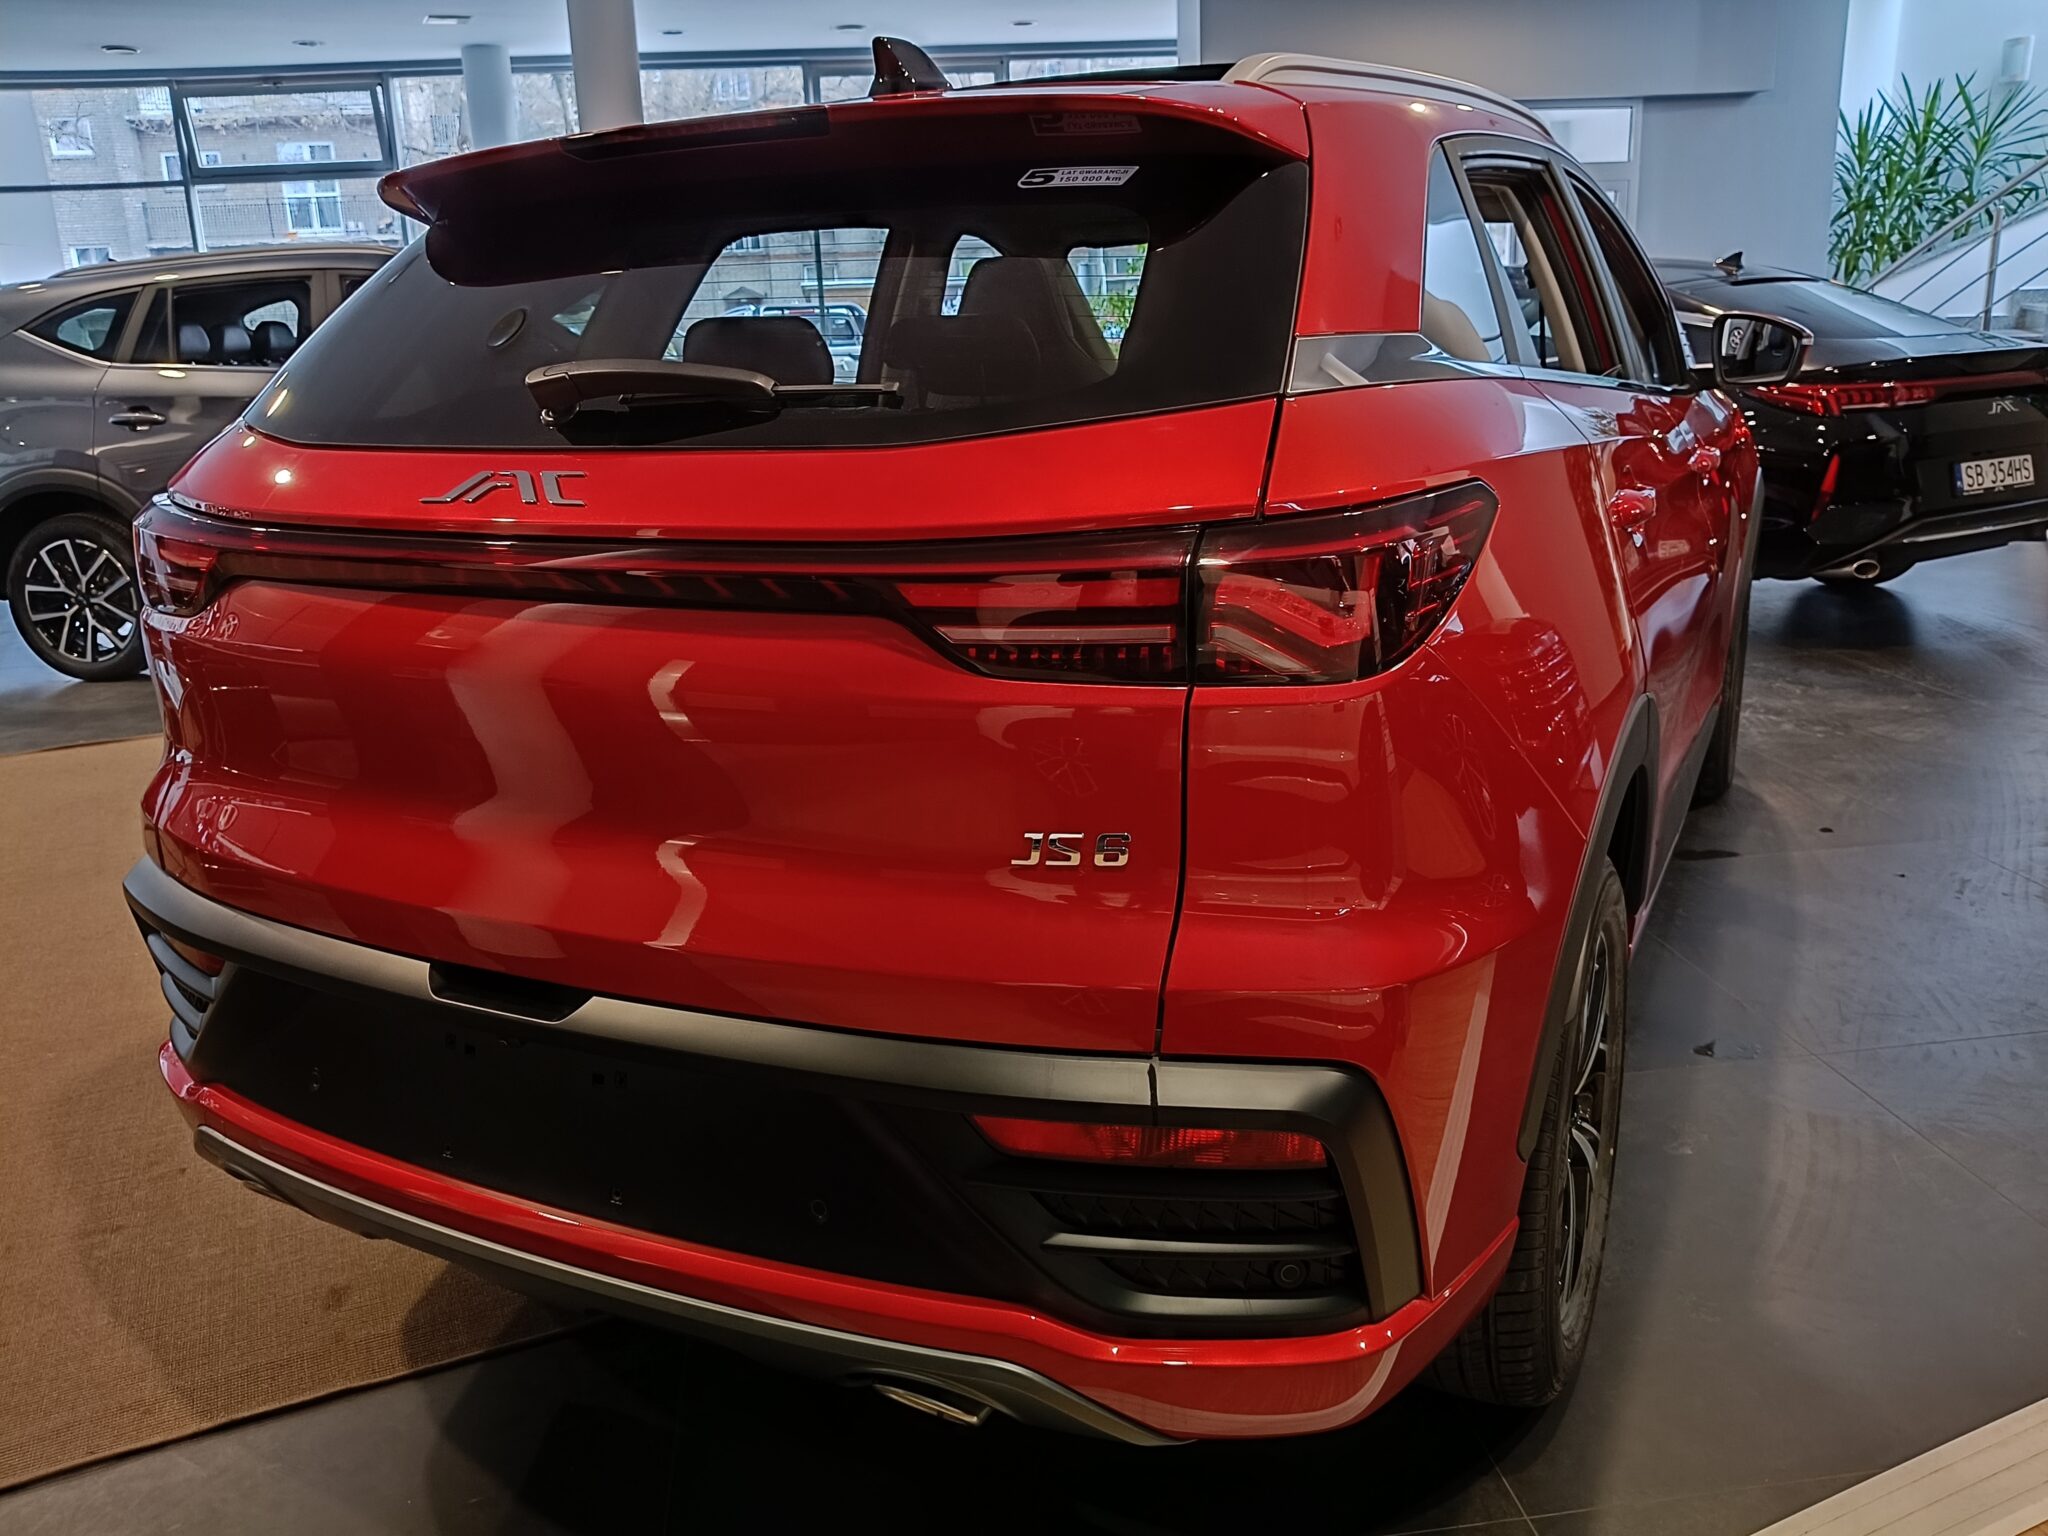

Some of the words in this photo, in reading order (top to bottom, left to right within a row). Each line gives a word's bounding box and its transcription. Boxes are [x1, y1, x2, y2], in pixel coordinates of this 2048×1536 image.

[1020, 169, 1059, 187] 5
[1965, 463, 1985, 488] SB
[1988, 457, 2032, 484] 354HS
